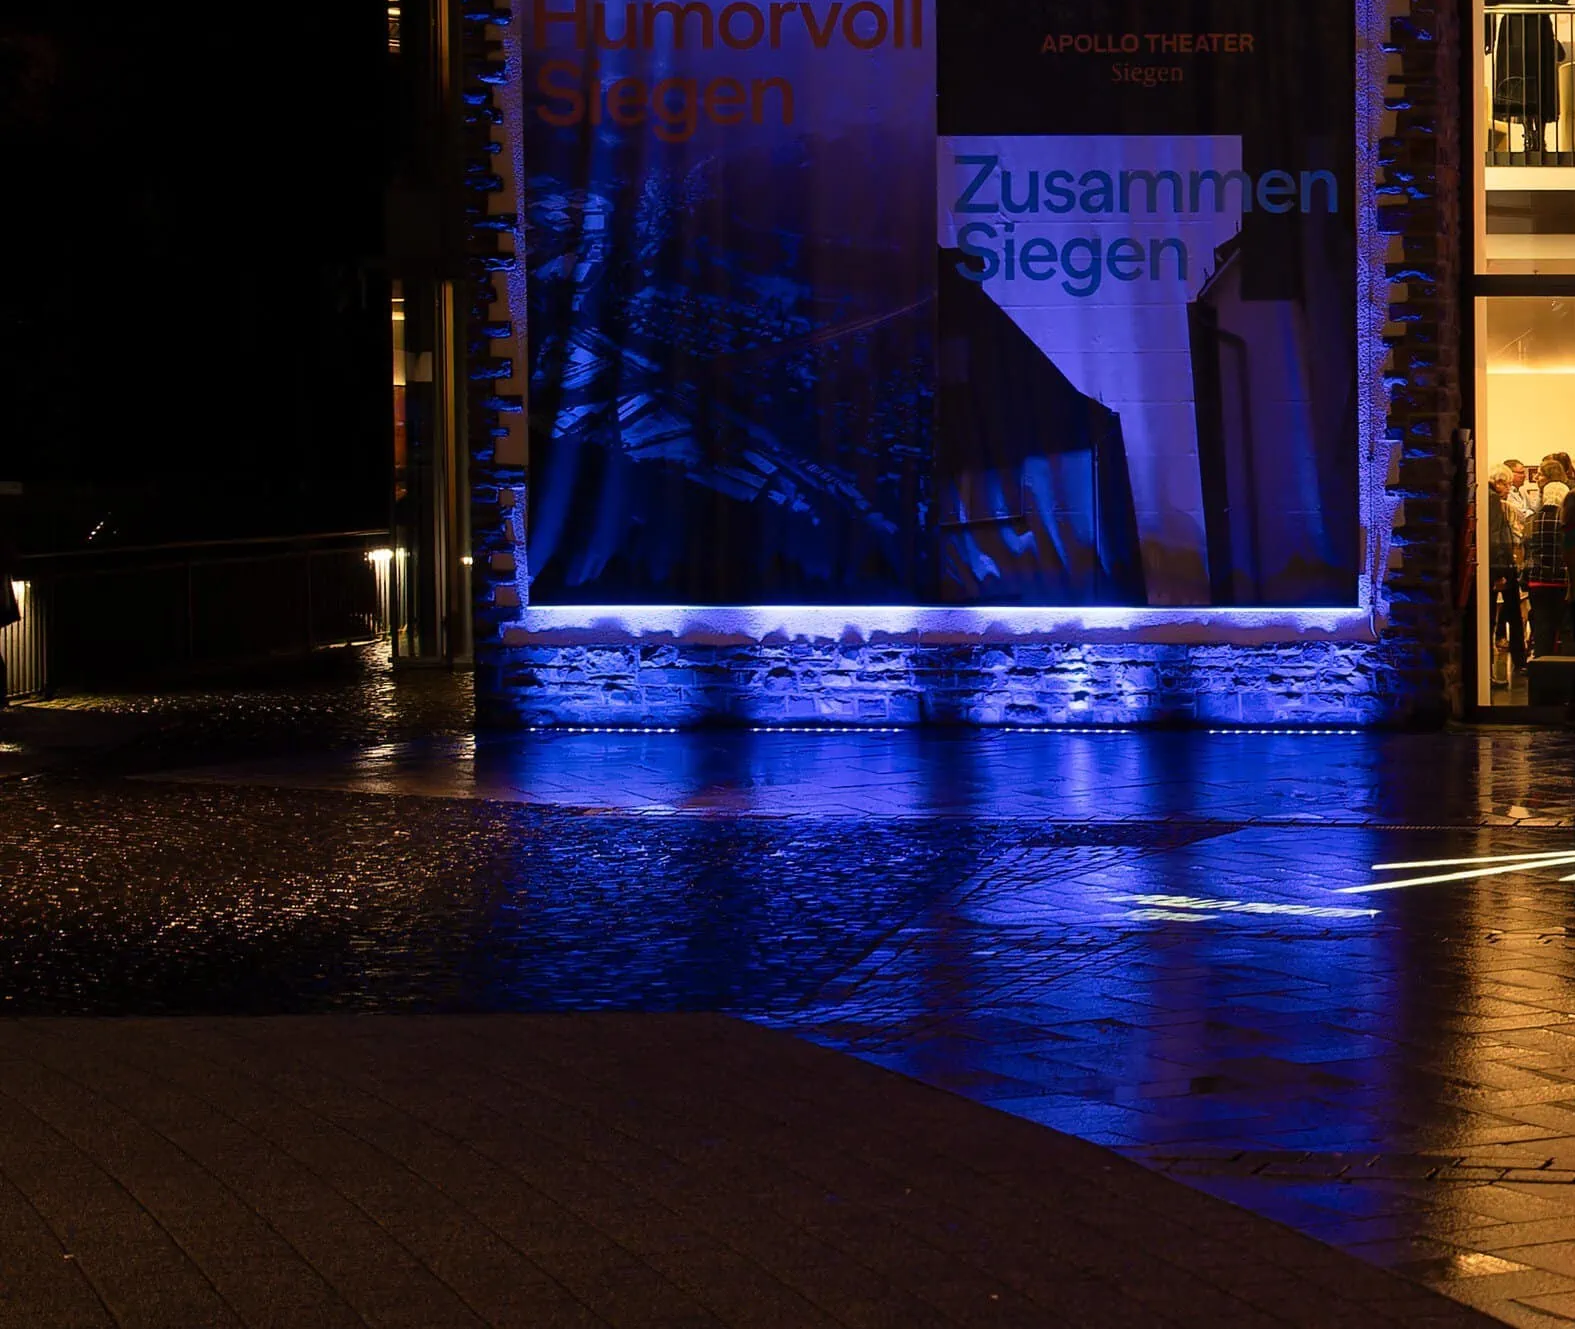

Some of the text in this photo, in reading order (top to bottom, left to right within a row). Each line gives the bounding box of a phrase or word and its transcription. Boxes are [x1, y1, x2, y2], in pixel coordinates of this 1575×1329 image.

[1041, 32, 1255, 54] APOLLO THEATER
[537, 59, 794, 143] Siegen
[1111, 62, 1184, 87] Siegen
[954, 155, 1339, 213] Zusammen
[956, 222, 1188, 297] Siegen
